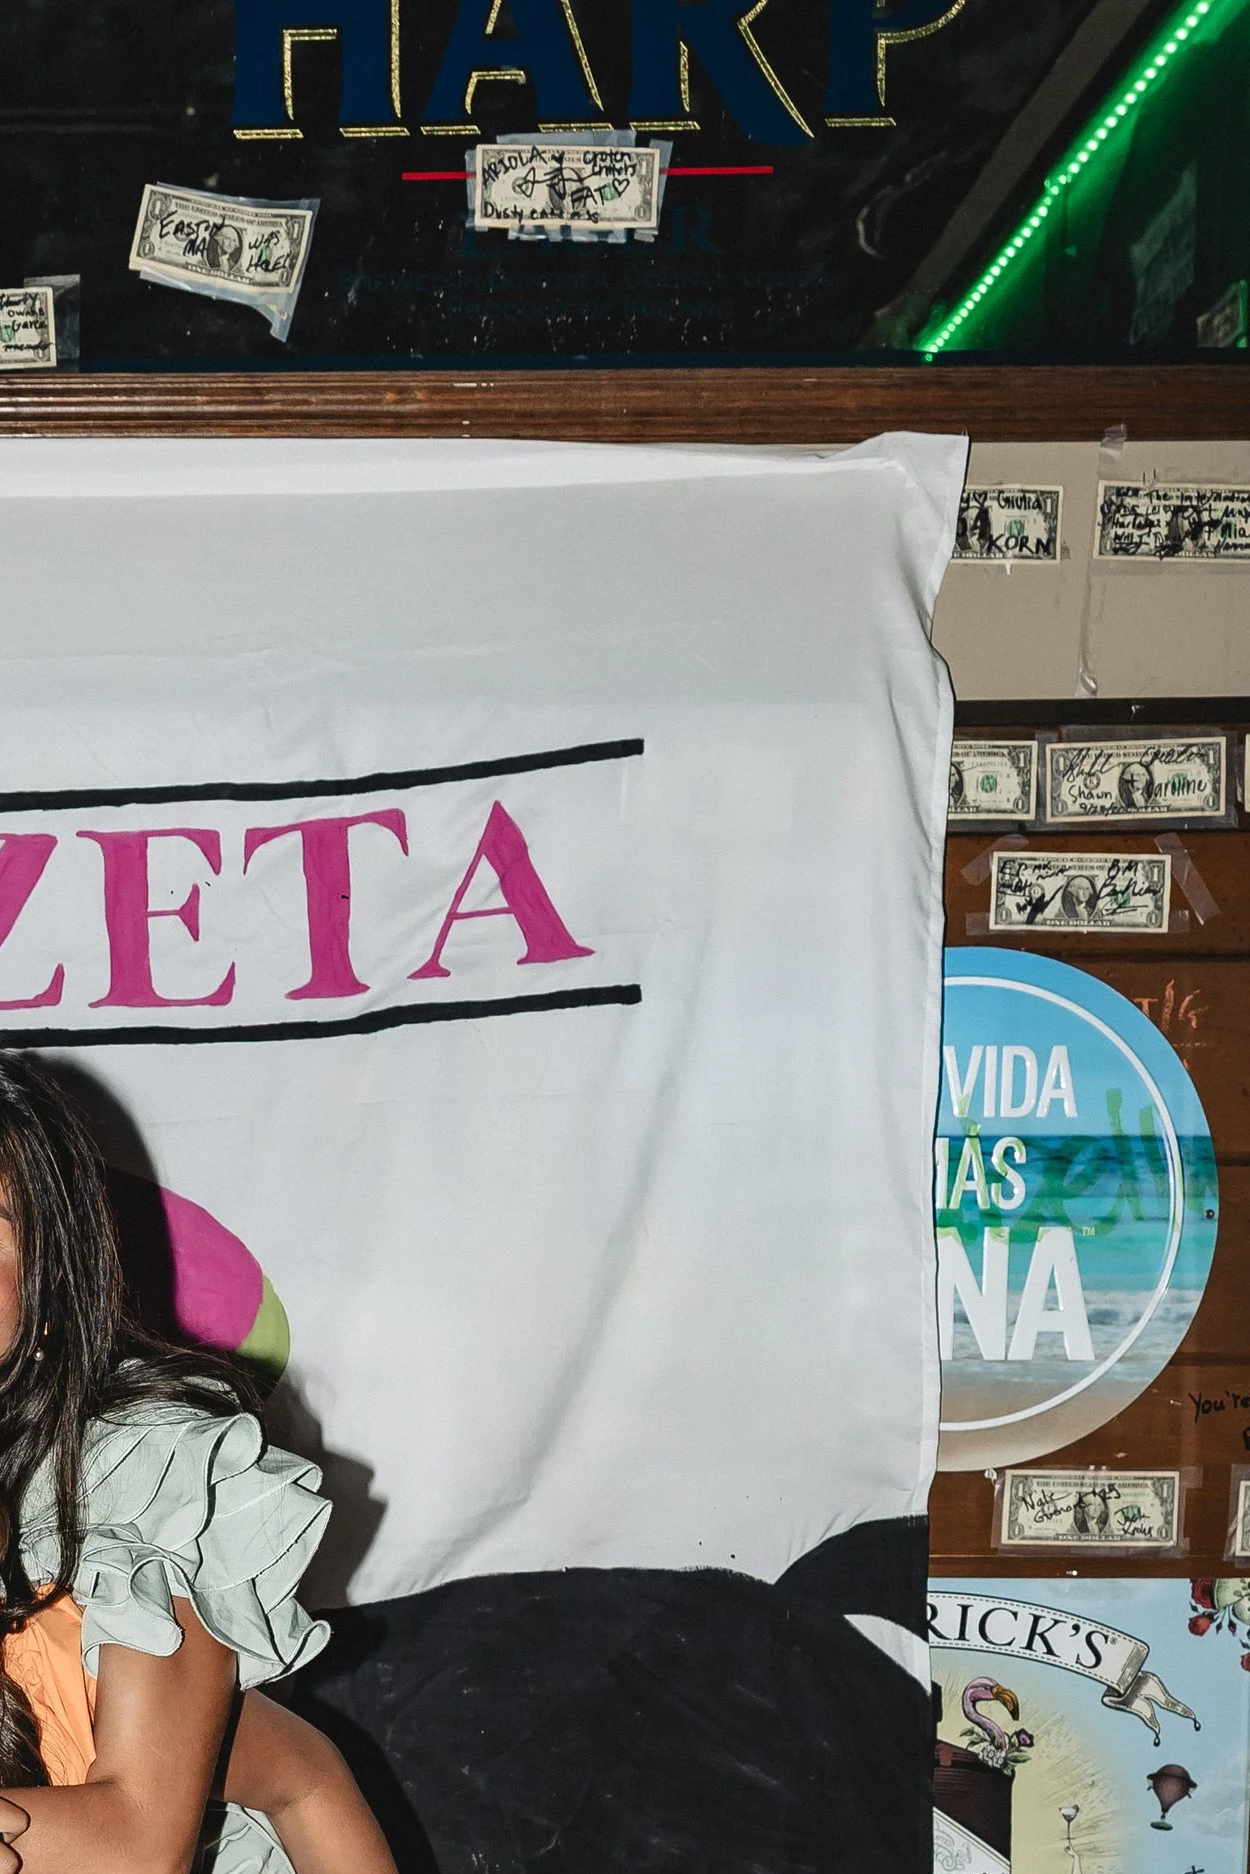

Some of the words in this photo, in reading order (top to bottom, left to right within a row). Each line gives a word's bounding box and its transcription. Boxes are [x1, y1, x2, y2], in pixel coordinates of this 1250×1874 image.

[231, 0, 964, 146] HARP
[159, 210, 227, 239] EASTON
[1068, 784, 1113, 804] Shawn
[943, 1044, 1078, 1119] VIDA
